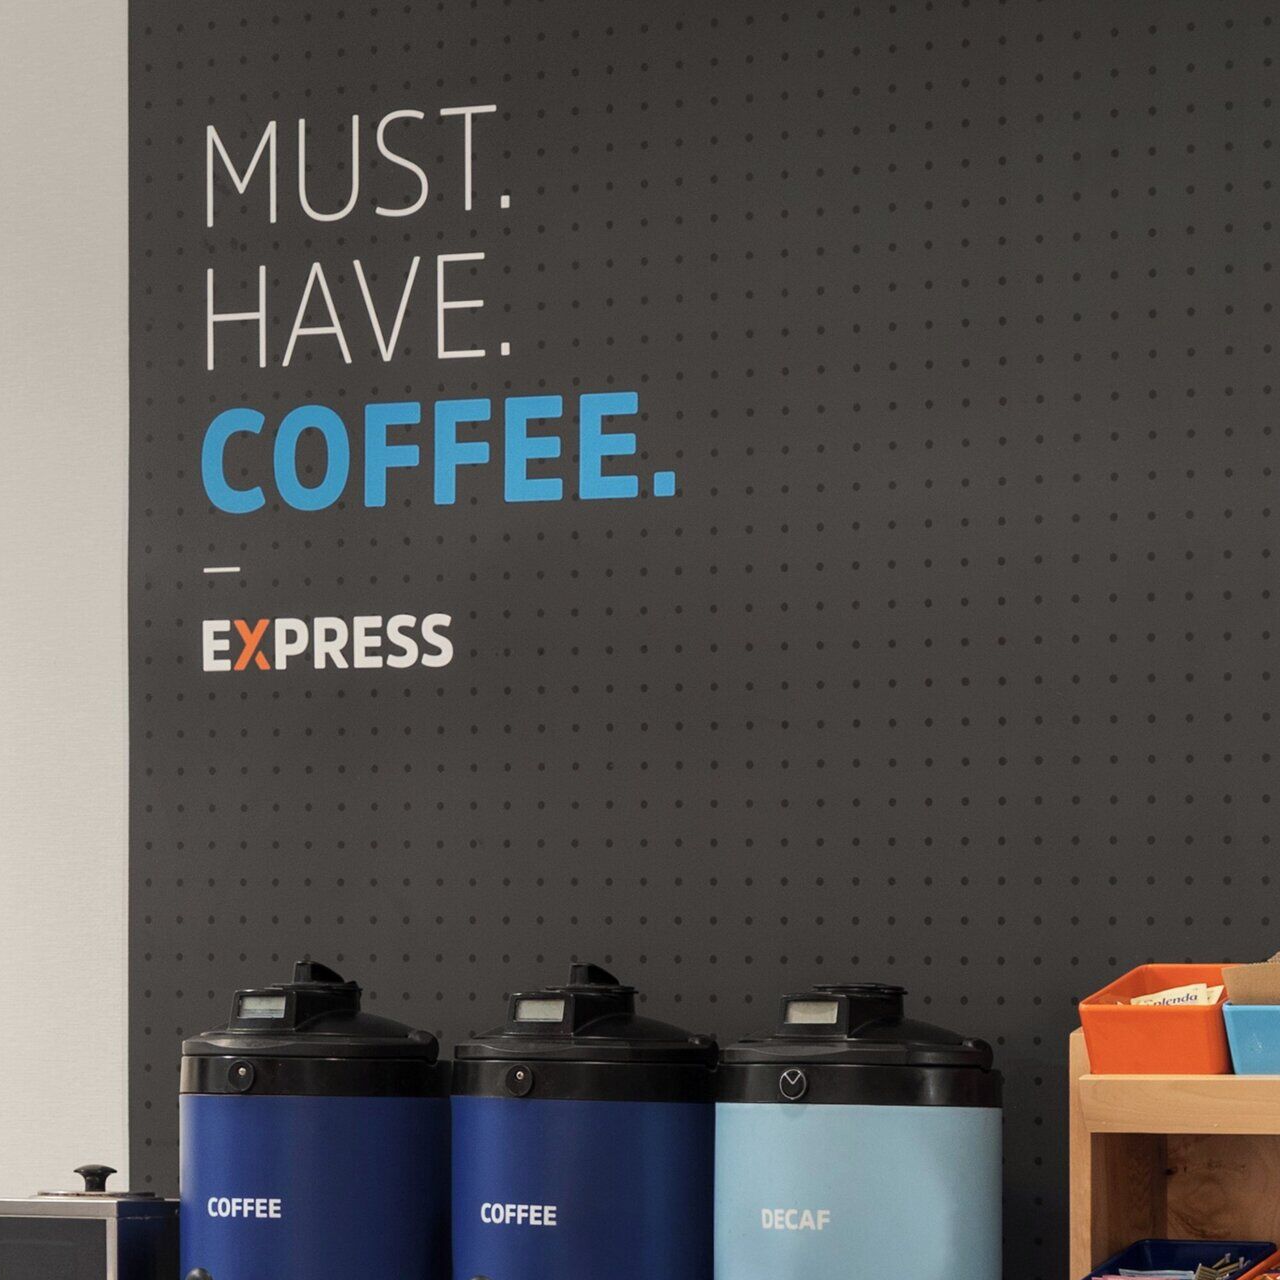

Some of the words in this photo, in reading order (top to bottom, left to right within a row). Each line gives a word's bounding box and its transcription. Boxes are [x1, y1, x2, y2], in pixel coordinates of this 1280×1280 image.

[206, 104, 511, 228] MUST.
[206, 252, 511, 371] HAVE.
[201, 391, 676, 514] COFFEE.
[202, 613, 454, 672] EXPRESS
[207, 1196, 282, 1218] COFFEE
[480, 1202, 557, 1226] COFFEE
[761, 1208, 831, 1231] DECAF
